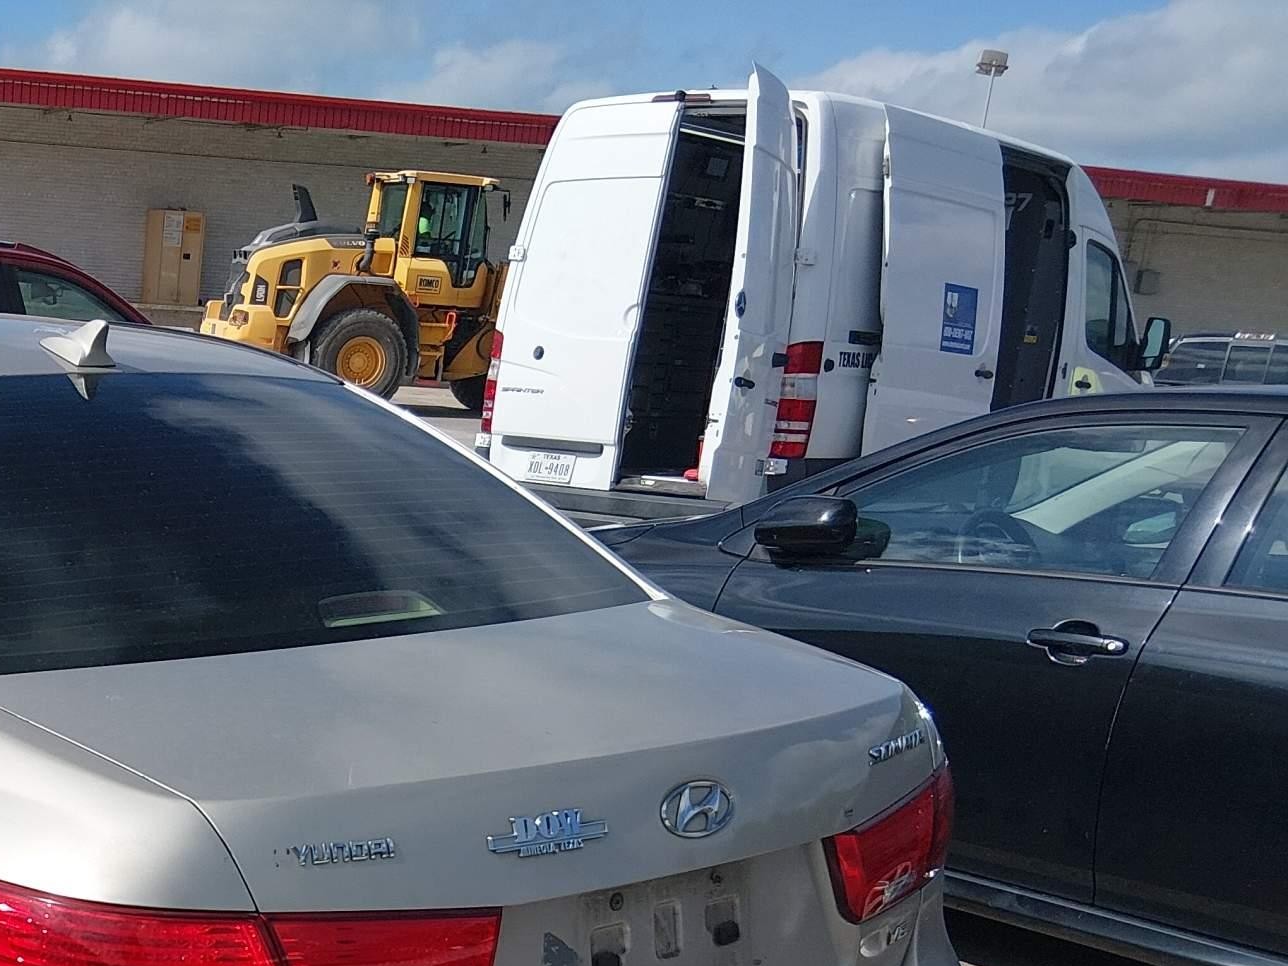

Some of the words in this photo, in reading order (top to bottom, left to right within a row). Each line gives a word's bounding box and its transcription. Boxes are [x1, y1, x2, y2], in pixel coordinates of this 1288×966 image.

[418, 278, 440, 288] ROMCO
[838, 352, 861, 368] TEXAS
[560, 838, 584, 851] TEXAS
